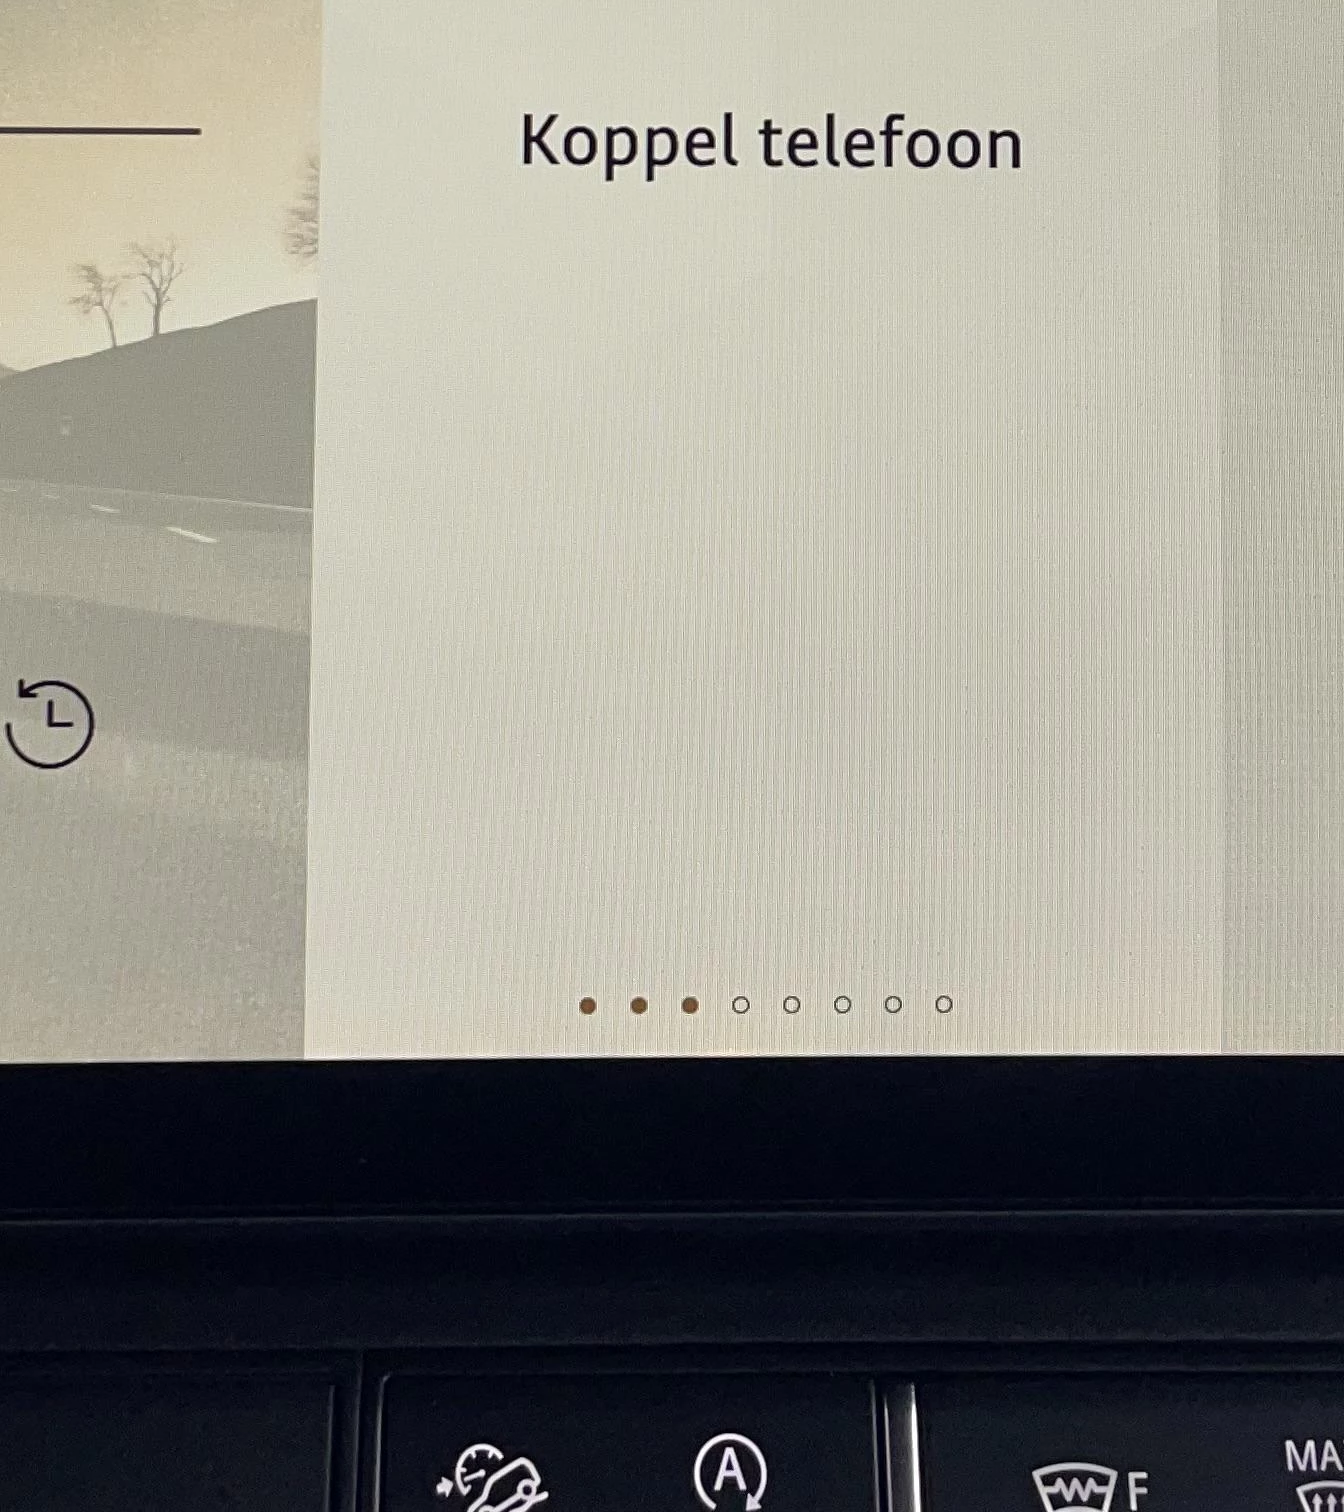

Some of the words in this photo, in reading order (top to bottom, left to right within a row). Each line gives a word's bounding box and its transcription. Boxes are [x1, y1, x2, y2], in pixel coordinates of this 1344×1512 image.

[521, 112, 739, 182] Koppel
[758, 113, 1022, 169] telefoon
[713, 1446, 747, 1492] A
[1128, 1471, 1149, 1512] F
